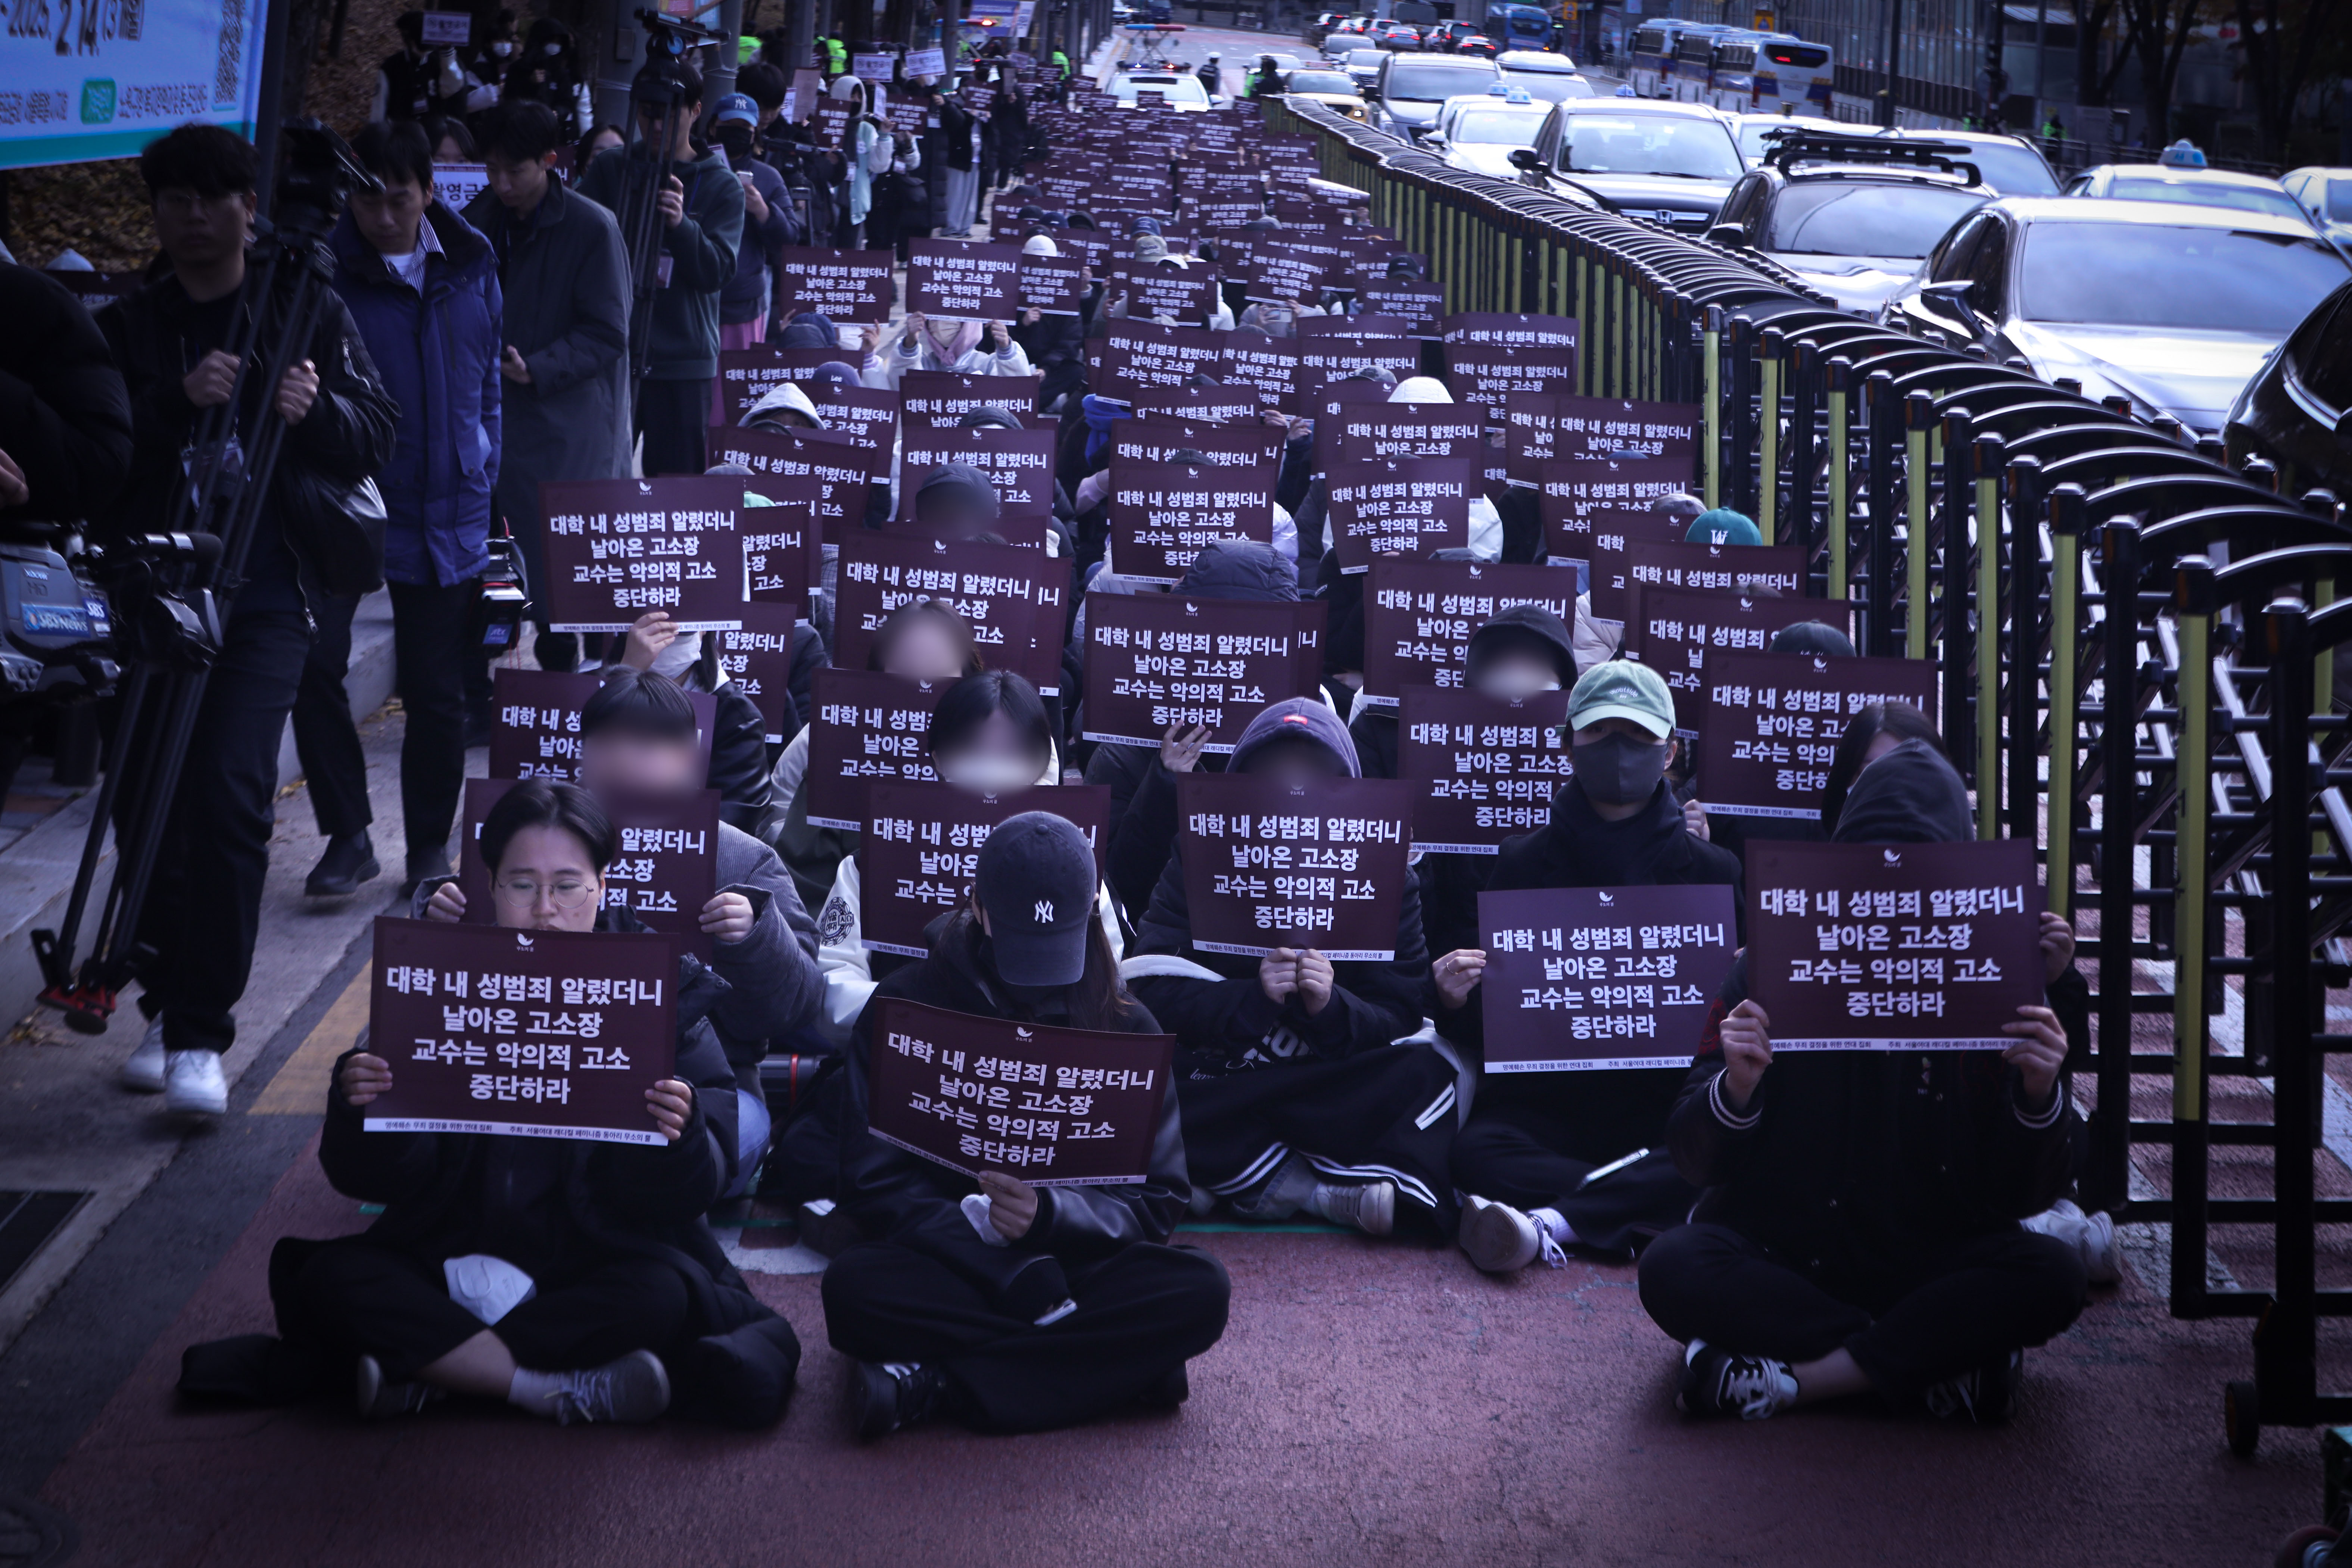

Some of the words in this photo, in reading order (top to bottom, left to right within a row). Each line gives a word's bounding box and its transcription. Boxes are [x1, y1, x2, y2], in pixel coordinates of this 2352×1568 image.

[735, 97, 747, 109] NY
[913, 256, 932, 267] 대학
[934, 257, 944, 268] 내
[946, 258, 975, 270] 성범죄
[978, 260, 1016, 273] 알렸더니
[933, 270, 962, 282] 날아온
[963, 273, 994, 284] 고소장
[920, 283, 950, 294] 교수는
[952, 284, 981, 297] 악의적
[983, 287, 1003, 297] 고소
[941, 297, 981, 310] 중단하라
[1118, 490, 1145, 506] 대학
[1149, 491, 1162, 507] 내
[1167, 492, 1208, 508] 성범죄
[1213, 492, 1266, 508] 알렸더니
[550, 515, 585, 535] 대학
[590, 514, 607, 534] 내
[613, 511, 666, 533] 성범죄
[672, 510, 734, 532] 알렸더니
[1149, 511, 1191, 527] 날아온
[1194, 511, 1236, 527] 고소장
[591, 538, 644, 559] 날아온
[649, 536, 700, 556] 고소장
[1133, 530, 1174, 546] 교수는
[1178, 531, 1219, 547] 악의적
[573, 564, 624, 584] 교수는
[629, 561, 680, 582] 악의적
[685, 562, 716, 579] 고소
[87, 600, 105, 618] SBS
[613, 586, 681, 608] 중단하라
[1095, 627, 1130, 648] 대학
[1135, 630, 1152, 650] 내
[1158, 632, 1210, 654] 성범죄
[1217, 635, 1287, 657] 알렸더니
[1134, 655, 1186, 677] 날아온
[1192, 660, 1246, 679] 고소장
[1113, 678, 1165, 699] 교수는
[1171, 682, 1223, 703] 악의적
[1229, 685, 1265, 703] 고소
[1713, 685, 1751, 708] 대학
[1758, 688, 1776, 710] 내
[1782, 690, 1840, 713] 성범죄
[1152, 705, 1223, 729] 중단하라
[1757, 715, 1814, 738] 날아온
[1732, 741, 1790, 763] 교수는
[1797, 744, 1835, 766] 악의
[1189, 813, 1225, 837] 대학
[1232, 815, 1250, 838] 내
[1258, 816, 1319, 840] 성범죄
[1327, 818, 1401, 844] 알렸더니
[1232, 845, 1292, 869] 날아온
[1299, 848, 1359, 872] 고소장
[1214, 875, 1267, 898] 교수는
[1274, 876, 1335, 901] 악의적
[1341, 880, 1375, 900] 고소
[1034, 900, 1053, 923] NY
[1761, 888, 1808, 917] 대학
[1816, 891, 1839, 917] 내
[1848, 891, 1920, 917] 성범죄
[1929, 885, 2024, 916] 알렸더니
[1255, 906, 1334, 931] 중단하라
[1493, 929, 1535, 952] 대학
[1542, 928, 1562, 951] 내
[1569, 926, 1632, 950] 성범죄
[1639, 923, 1724, 949] 알렸더니
[1817, 925, 1890, 951] 날아온
[1898, 923, 1972, 950] 고소장
[1543, 957, 1607, 980] 날아온
[1614, 954, 1677, 978] 고소장
[1789, 959, 1862, 984] 교수는
[1870, 958, 1943, 984] 악의적
[1953, 958, 2001, 981] 고소
[387, 966, 436, 996] 대학
[445, 971, 468, 998] 내
[477, 973, 551, 1003] 성범죄
[561, 978, 662, 1006] 알렸더니
[1520, 987, 1584, 1010] 교수는
[1591, 985, 1654, 1009] 악의적
[1661, 984, 1704, 1005] 고소
[1847, 991, 1945, 1017] 중단하라
[443, 1005, 518, 1034] 날아온
[526, 1011, 603, 1038] 고소장
[1571, 1014, 1657, 1039] 중단하라
[412, 1039, 488, 1066] 교수는
[496, 1042, 571, 1071] 악의적
[580, 1047, 630, 1070] 고소
[888, 1032, 935, 1064] 대학
[942, 1050, 965, 1073] 내
[973, 1056, 1047, 1086] 성범죄
[1056, 1067, 1154, 1090] 알렸더니
[470, 1074, 571, 1104] 중단하라
[939, 1075, 1010, 1109] 날아온
[1018, 1091, 1094, 1115] 고소장
[909, 1092, 978, 1129] 교수는
[987, 1115, 1060, 1141] 악의적
[1067, 1122, 1115, 1139] 고소
[959, 1132, 1057, 1166] 중단하라
